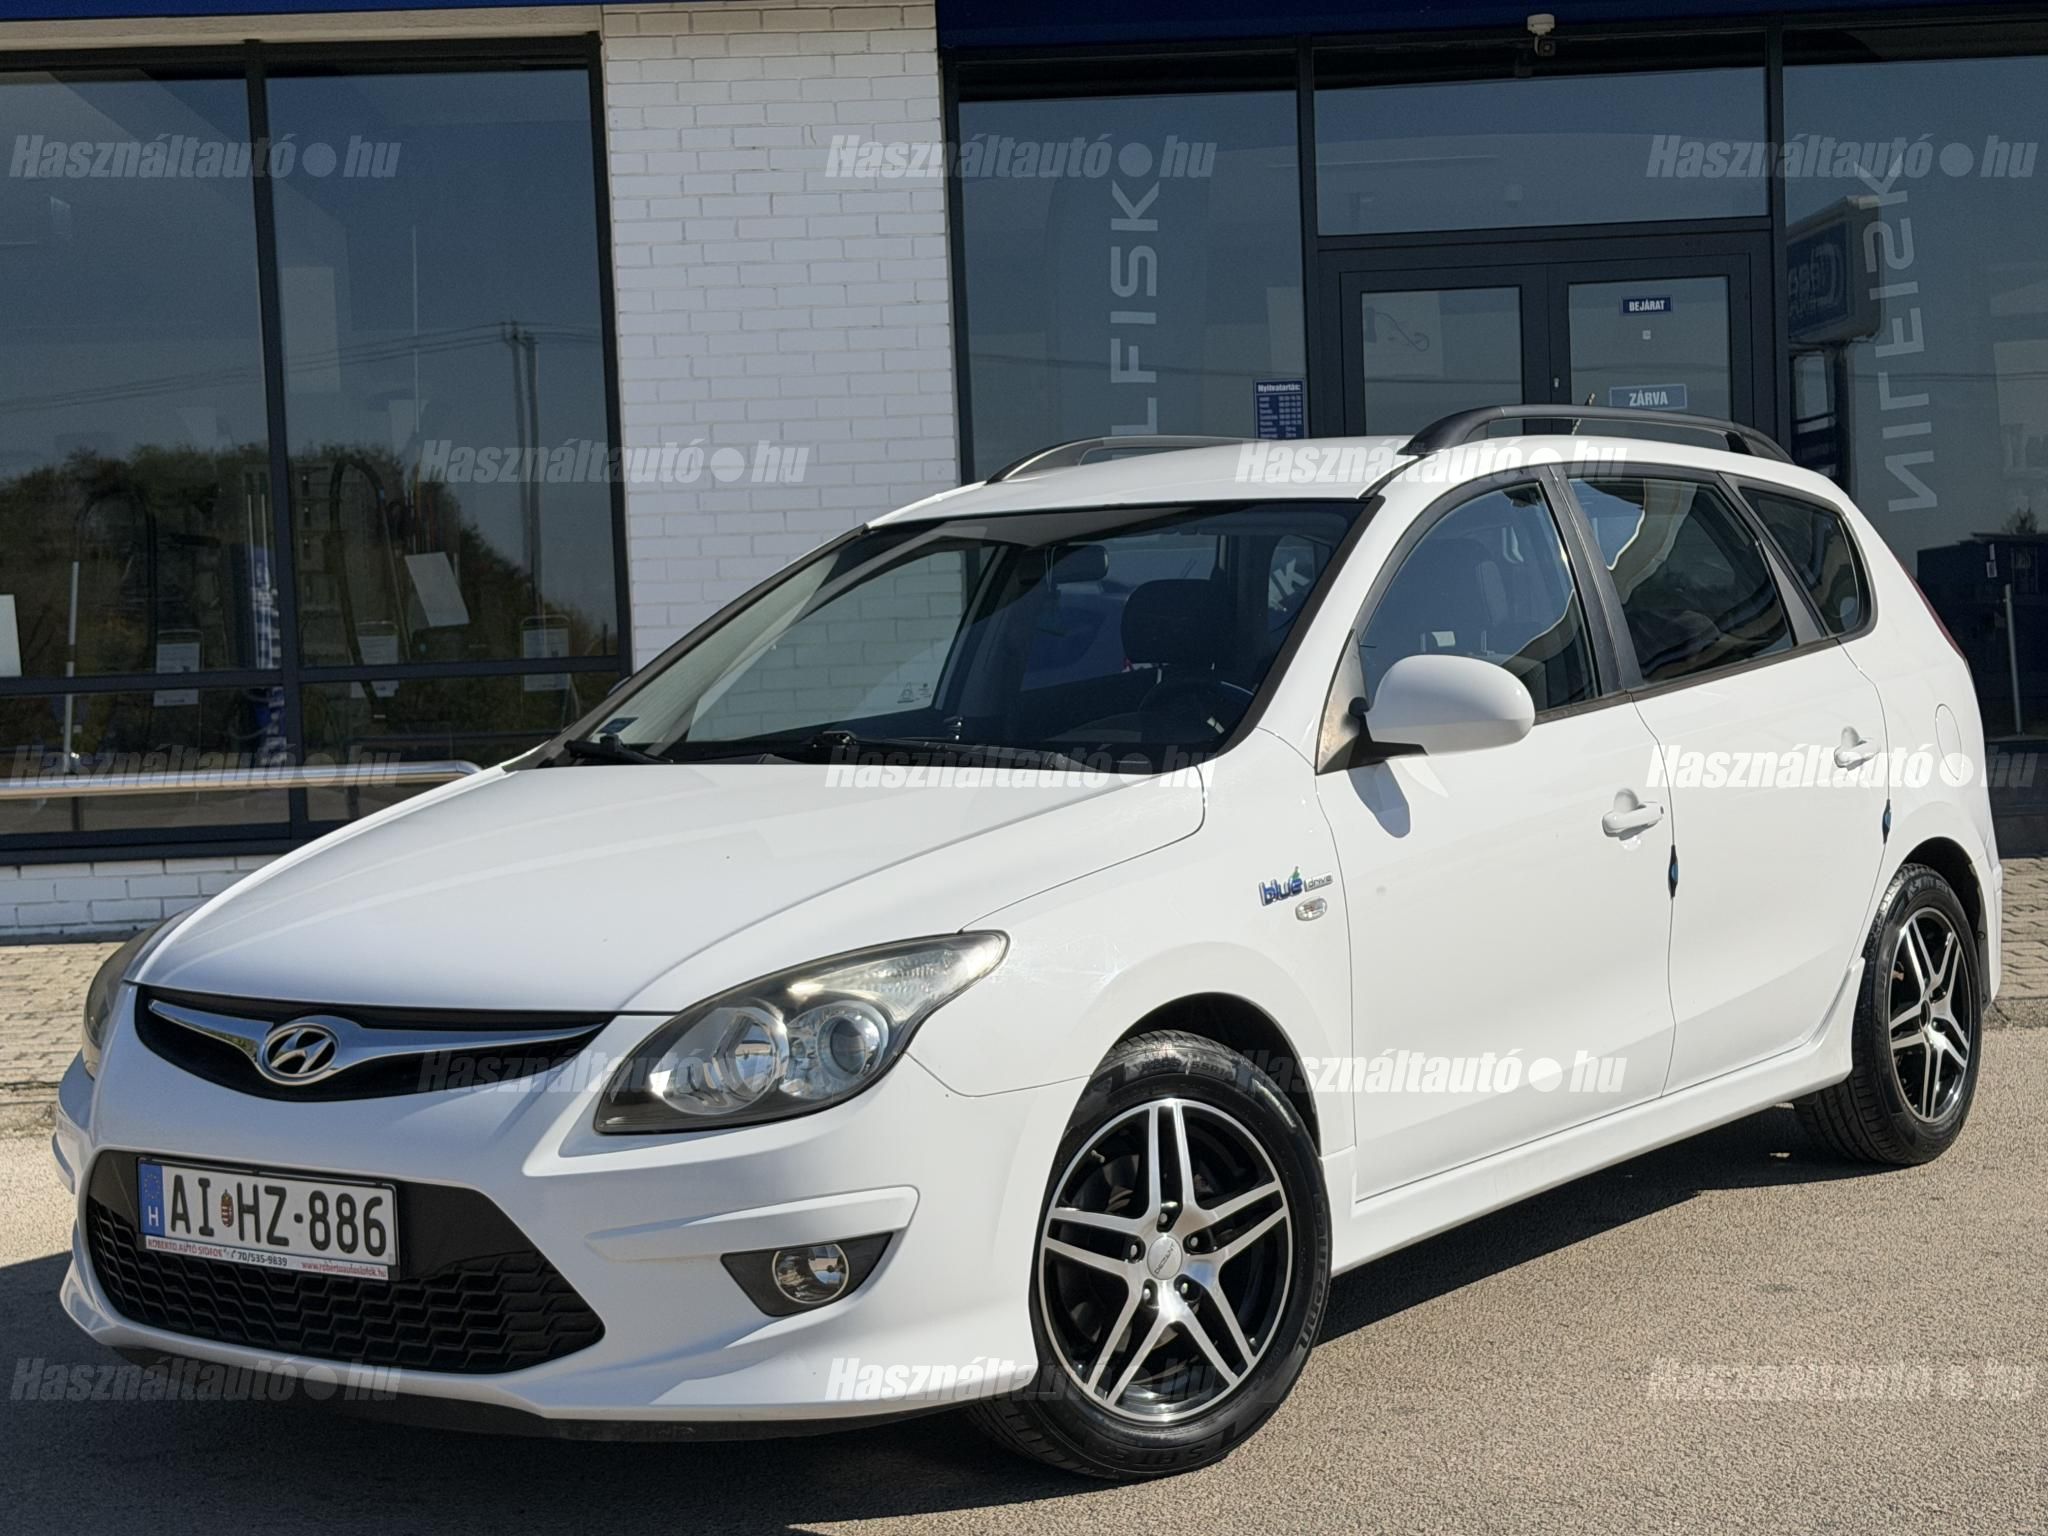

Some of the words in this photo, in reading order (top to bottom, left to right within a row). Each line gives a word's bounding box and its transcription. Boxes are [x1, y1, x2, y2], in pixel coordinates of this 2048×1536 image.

[1628, 298, 1665, 312] BEJÁRAT
[1628, 390, 1669, 407] ZÁRVA
[1258, 867, 1303, 906] blue
[147, 1206, 160, 1229] H
[170, 1174, 215, 1238] AI
[237, 1182, 387, 1258] HZ-886
[237, 1251, 289, 1267] 70/535-9839
